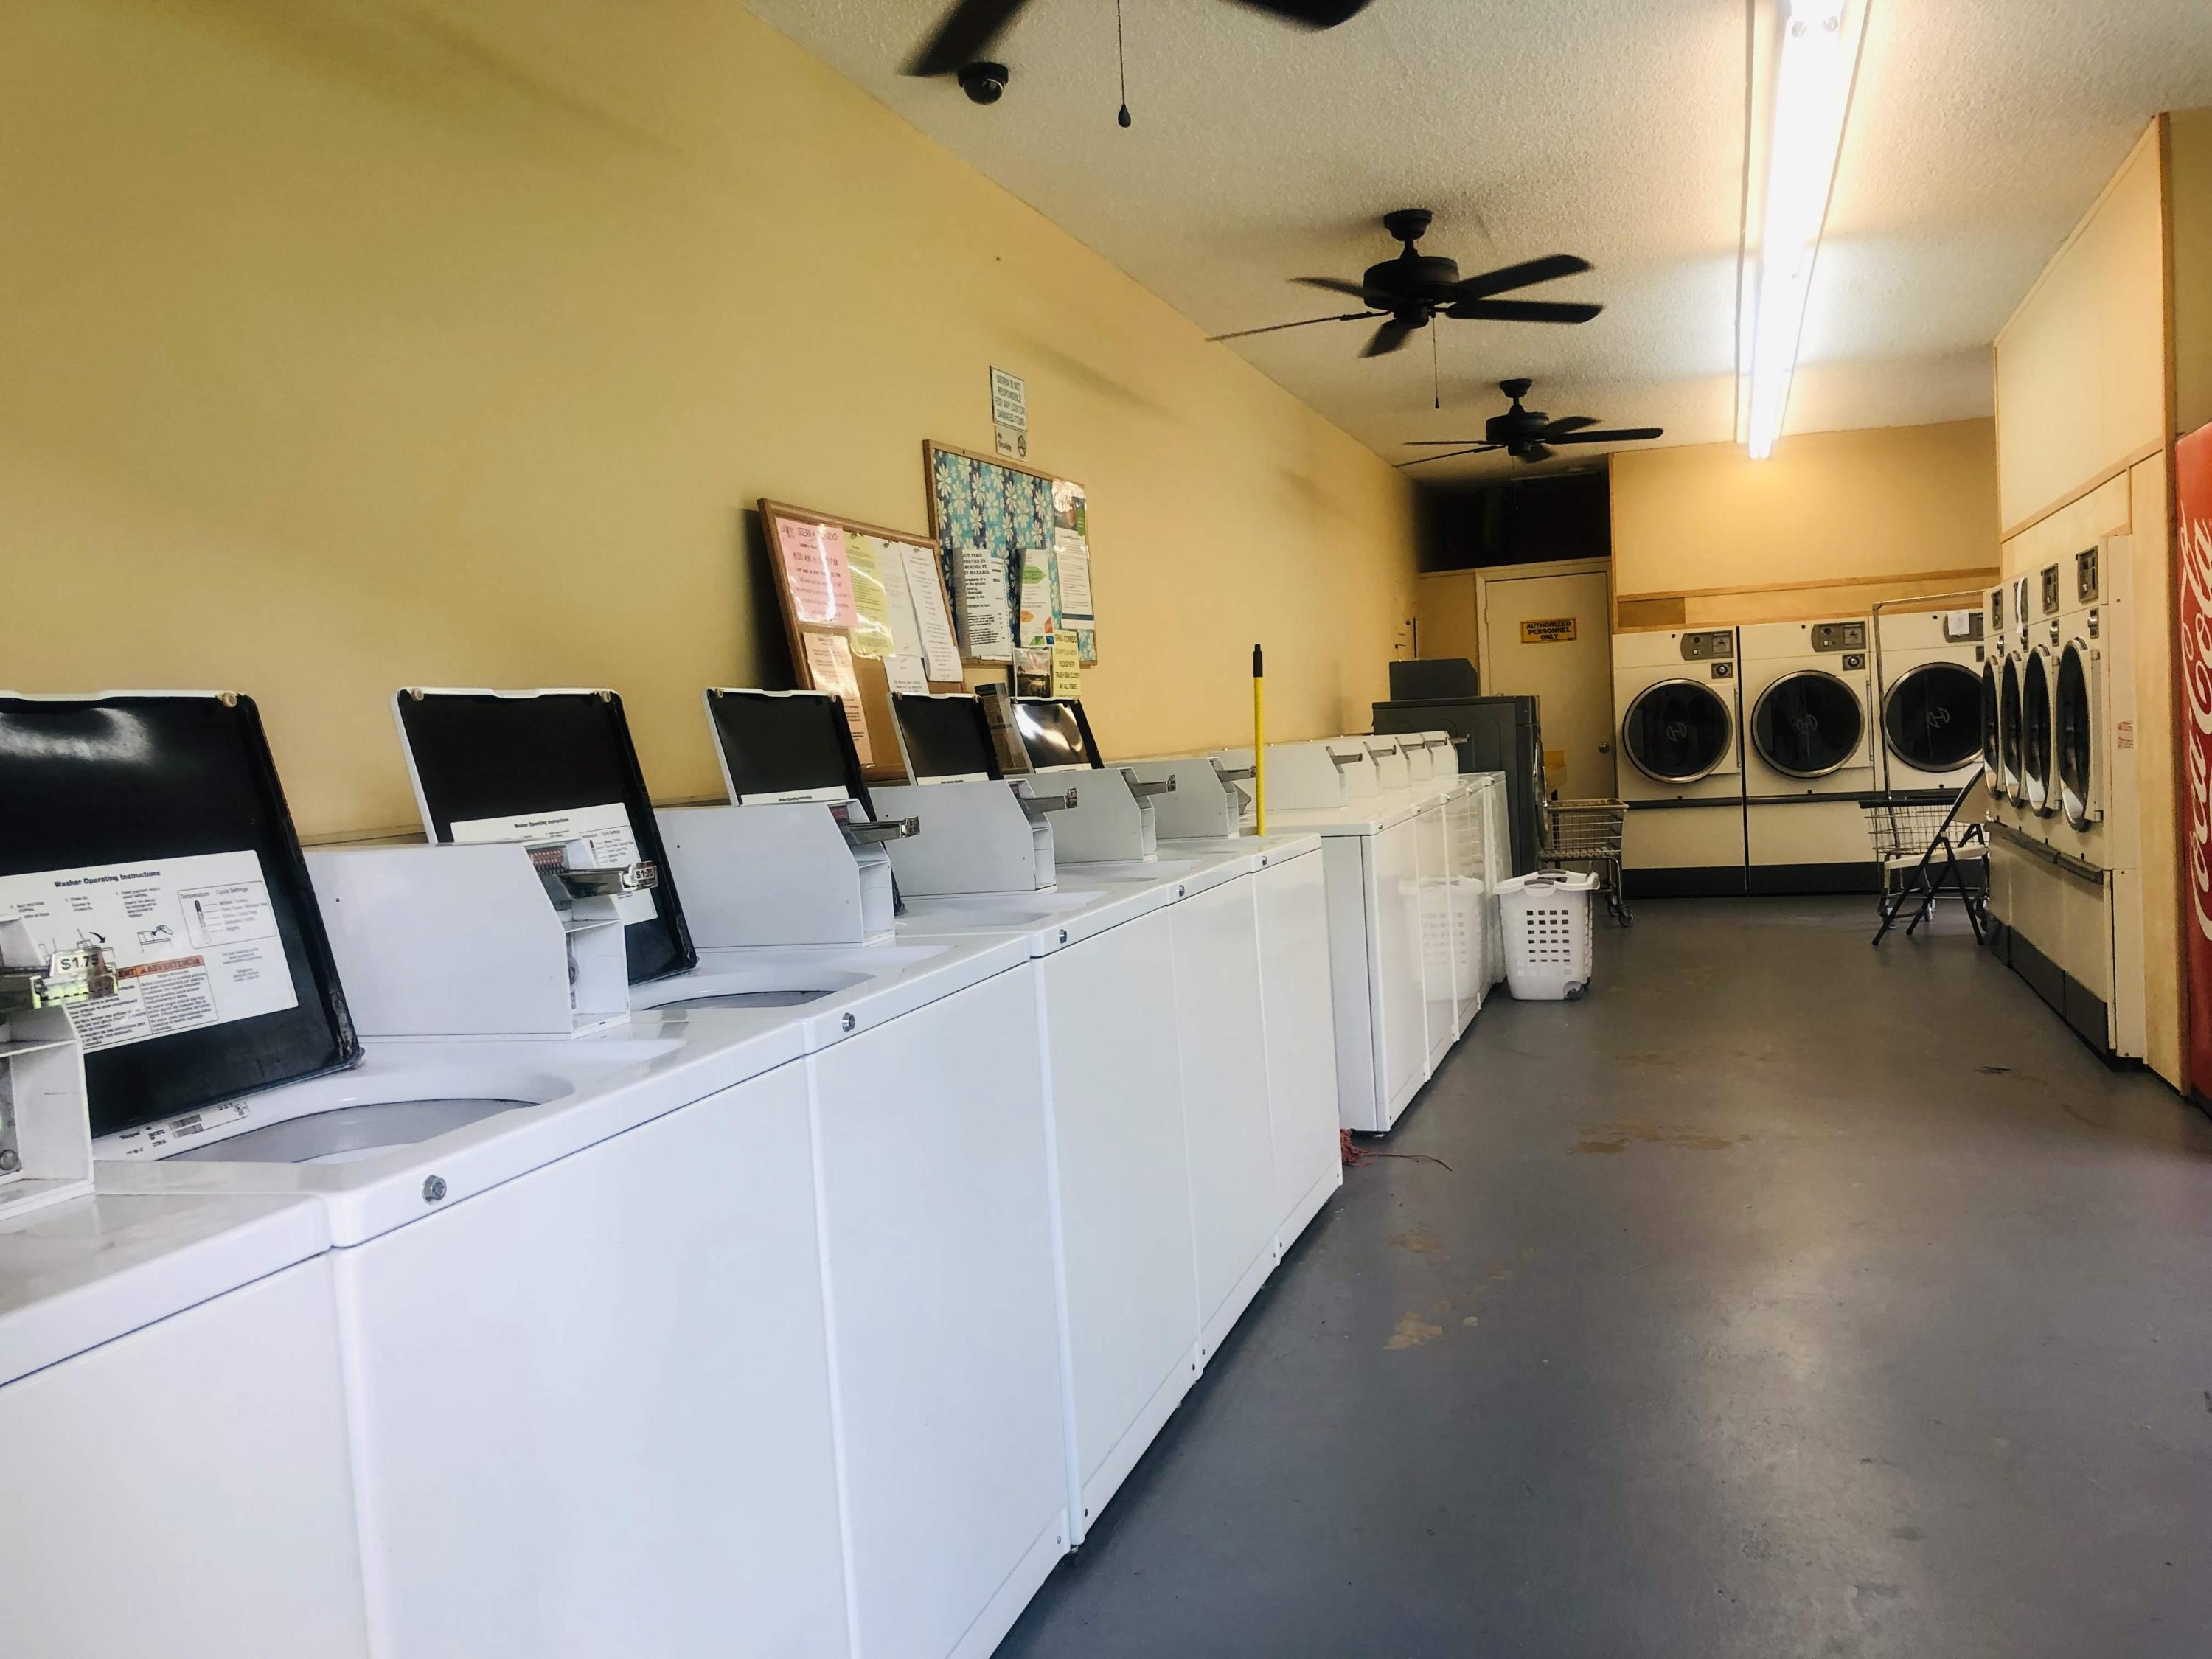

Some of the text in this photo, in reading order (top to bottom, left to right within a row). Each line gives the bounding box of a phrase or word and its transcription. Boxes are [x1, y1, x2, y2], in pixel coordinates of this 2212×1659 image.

[1526, 621, 1571, 629] AUTHORIZED
[2179, 499, 2212, 941] Coca-Cola
[53, 870, 161, 888] Washer Operating Instructions
[61, 954, 99, 970] $1.75
[147, 958, 201, 973] ADVERTENCIA
